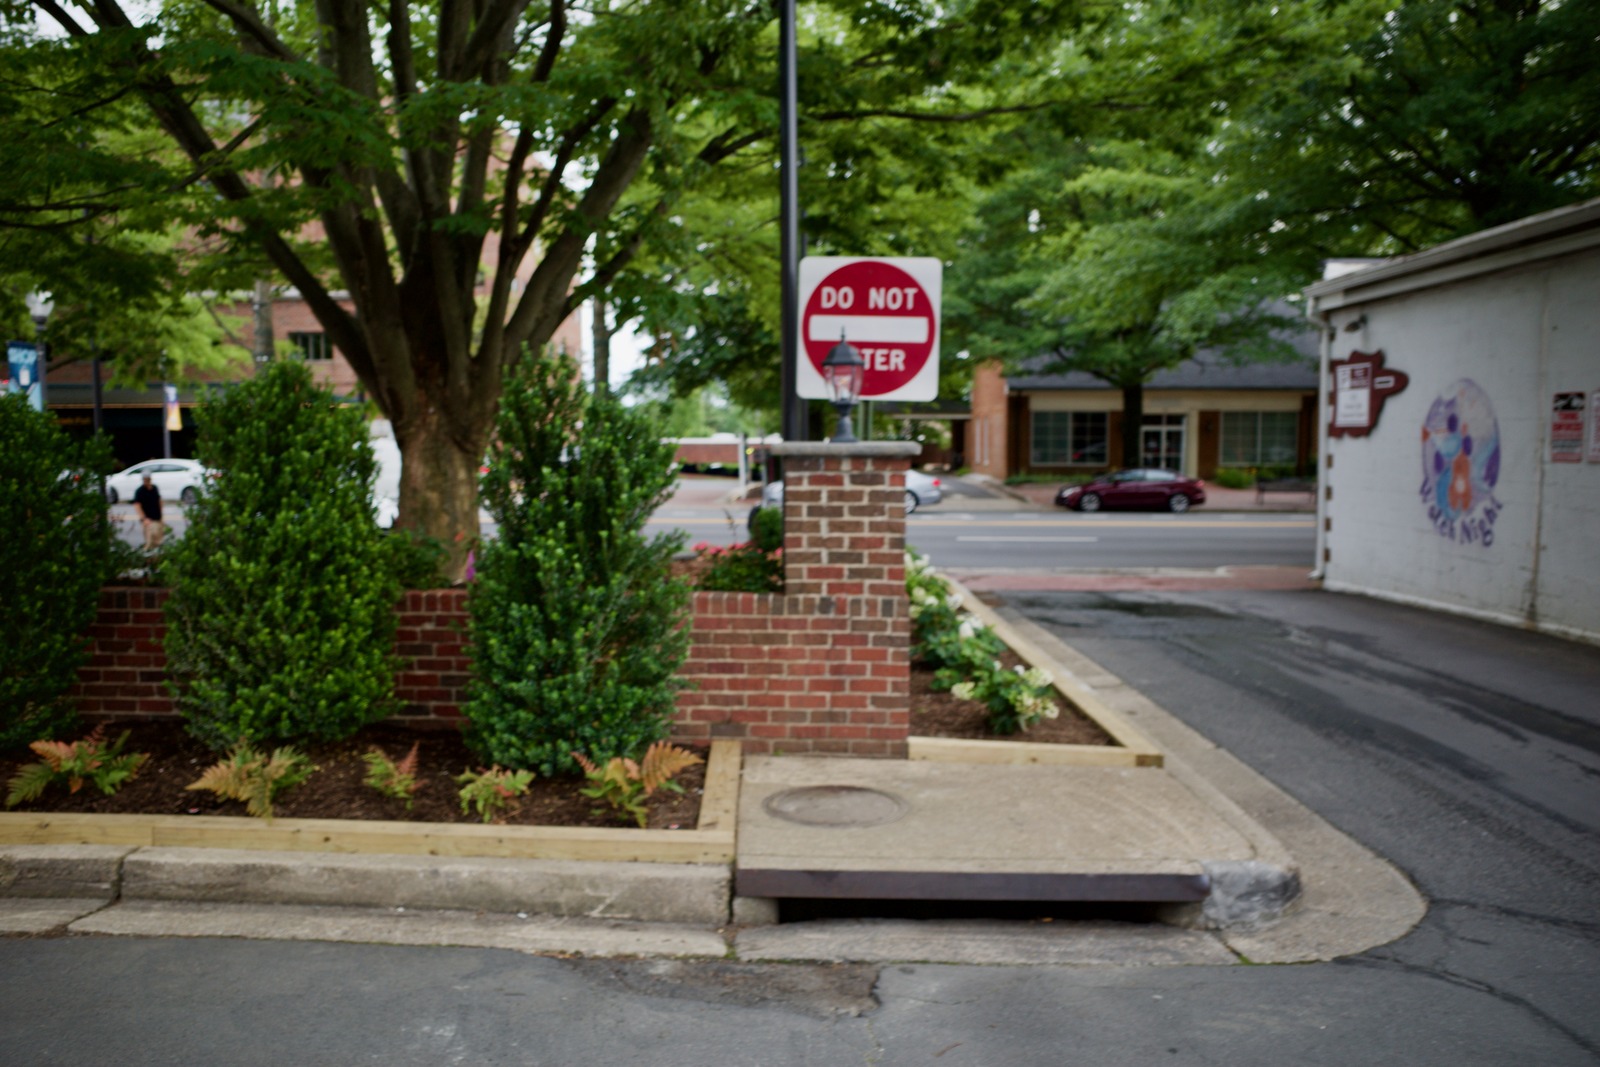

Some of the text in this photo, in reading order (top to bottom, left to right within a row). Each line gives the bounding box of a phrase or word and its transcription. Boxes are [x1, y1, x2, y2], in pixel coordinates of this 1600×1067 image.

[820, 286, 919, 311] DO NOT
[856, 348, 906, 372] TER
[1459, 495, 1503, 548] Night
